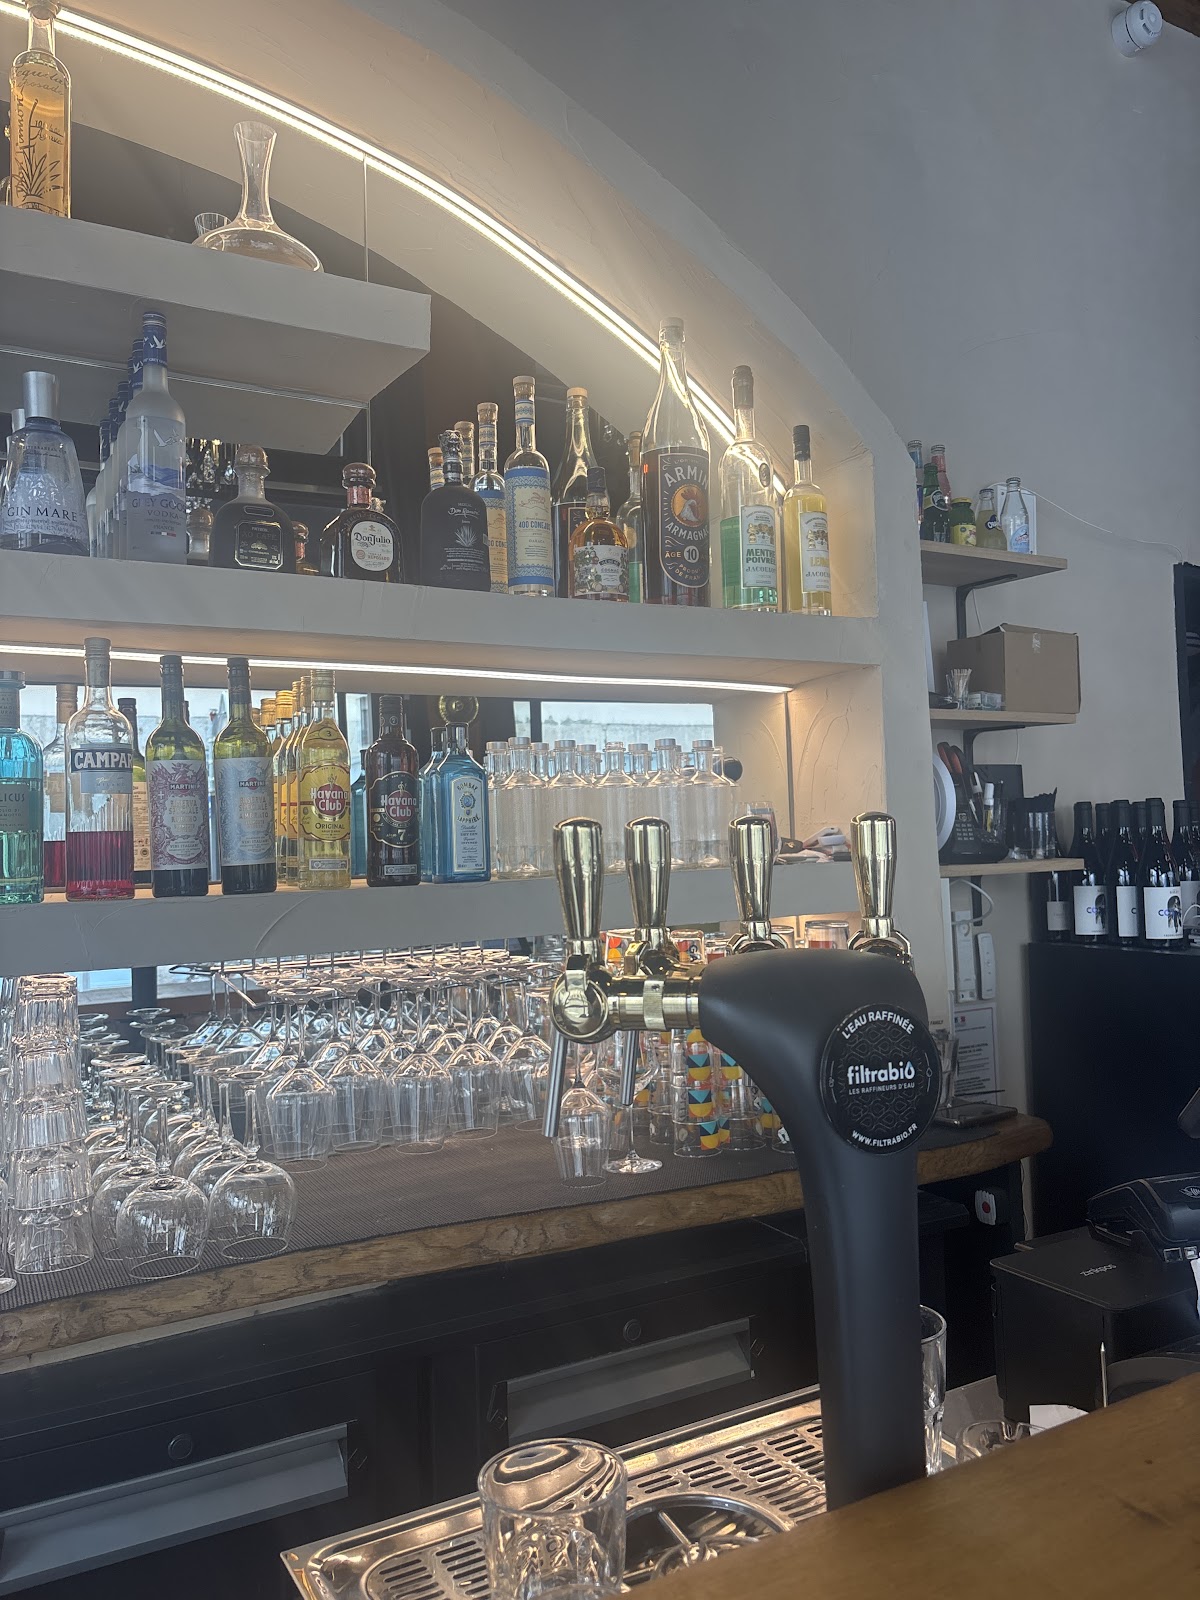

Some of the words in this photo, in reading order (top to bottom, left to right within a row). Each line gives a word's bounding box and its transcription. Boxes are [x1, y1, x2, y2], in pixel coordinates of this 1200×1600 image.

[7, 506, 31, 518] GIN
[36, 507, 78, 522] MARE
[147, 510, 179, 520] VODKA
[686, 547, 698, 561] 10
[310, 787, 348, 800] Havana
[318, 800, 342, 811] Club
[380, 795, 417, 806] Havana
[389, 806, 412, 817] Club
[315, 822, 345, 830] ORIGINAL
[397, 829, 406, 841] 7
[841, 1013, 868, 1040] L'EAU
[867, 1010, 915, 1035] RAFFINÉE
[847, 1060, 915, 1085] filtrabio
[848, 1088, 861, 1097] LES
[860, 1084, 898, 1096] RAFFINEURS
[898, 1082, 916, 1091] D'EAU
[851, 1122, 919, 1148] WWW.FILTRABIO.FR
